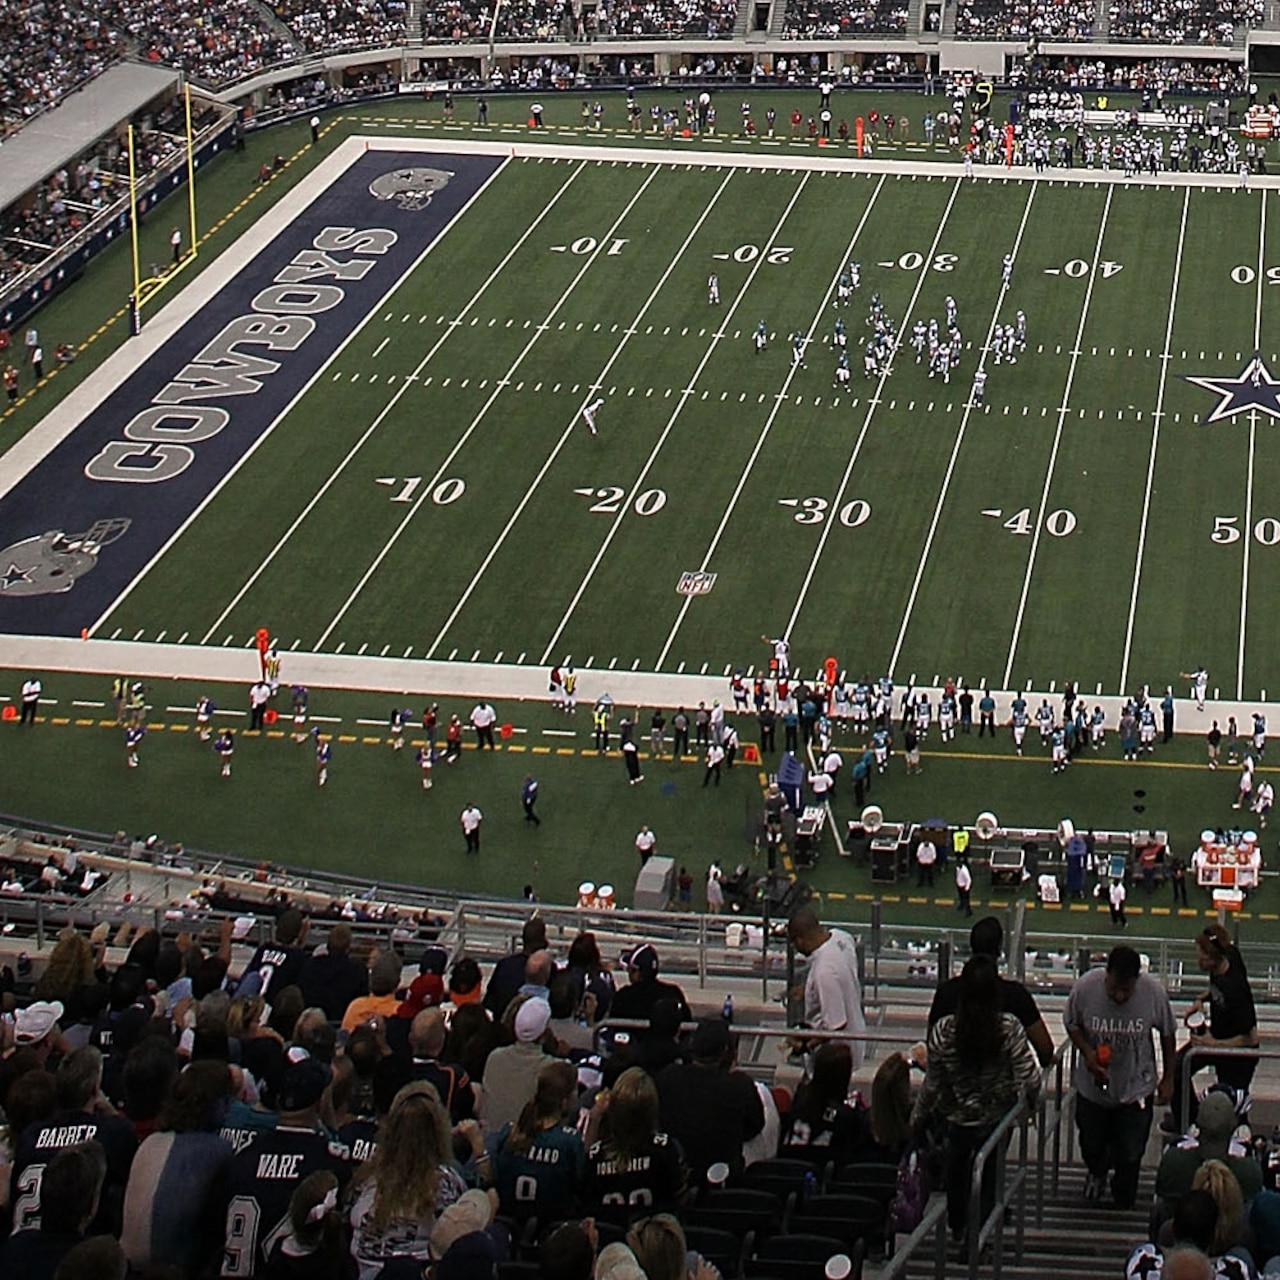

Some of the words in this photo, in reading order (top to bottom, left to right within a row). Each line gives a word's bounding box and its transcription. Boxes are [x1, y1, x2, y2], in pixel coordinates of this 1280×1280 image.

[84, 226, 398, 483] COWBOYS
[389, 477, 466, 506] 10
[589, 486, 667, 517] 20
[794, 497, 872, 527] 30
[1003, 507, 1078, 537] 40
[1091, 1016, 1145, 1033] DALLAS
[34, 1124, 97, 1149] BARBER
[256, 1153, 304, 1179] WARE
